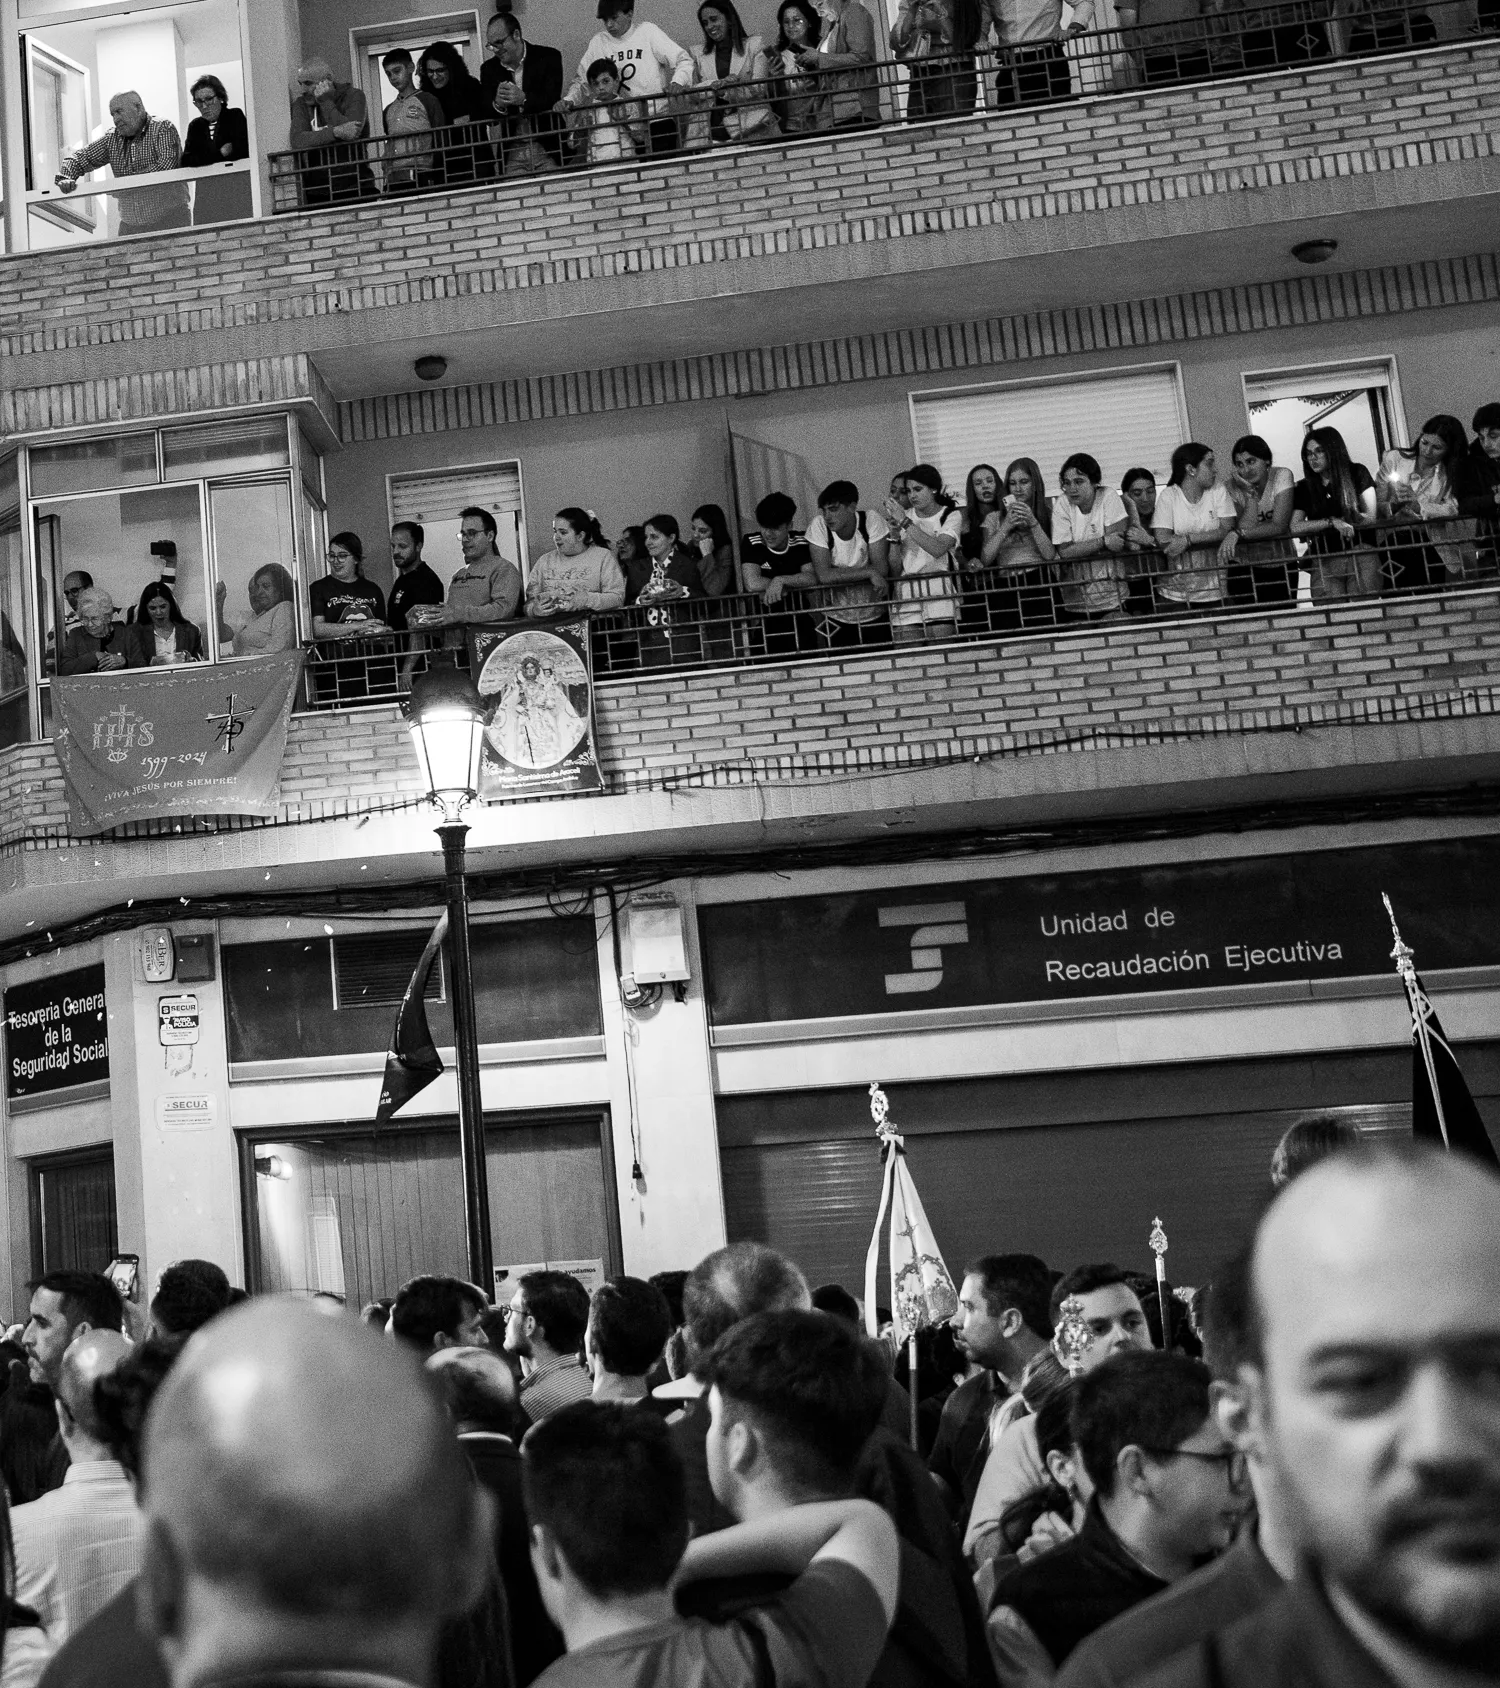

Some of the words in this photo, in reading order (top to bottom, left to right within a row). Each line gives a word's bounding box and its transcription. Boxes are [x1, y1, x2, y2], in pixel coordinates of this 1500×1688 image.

[92, 720, 155, 750] IHS
[140, 751, 208, 779] 1599-2024
[104, 790, 130, 801] ¡VIVA
[163, 780, 184, 789] POR
[186, 776, 238, 788] SIEMPRE!
[1040, 909, 1129, 936] Unidad
[1144, 906, 1176, 927] de
[1045, 949, 1210, 982] Recaudación
[1224, 940, 1343, 972] Ejecutiva
[170, 1004, 196, 1012] SECUR
[45, 1027, 59, 1047] de
[62, 1024, 72, 1043] la
[12, 1046, 70, 1079] Seguridad
[73, 1037, 109, 1064] Social
[172, 1100, 208, 1109] SECUR
